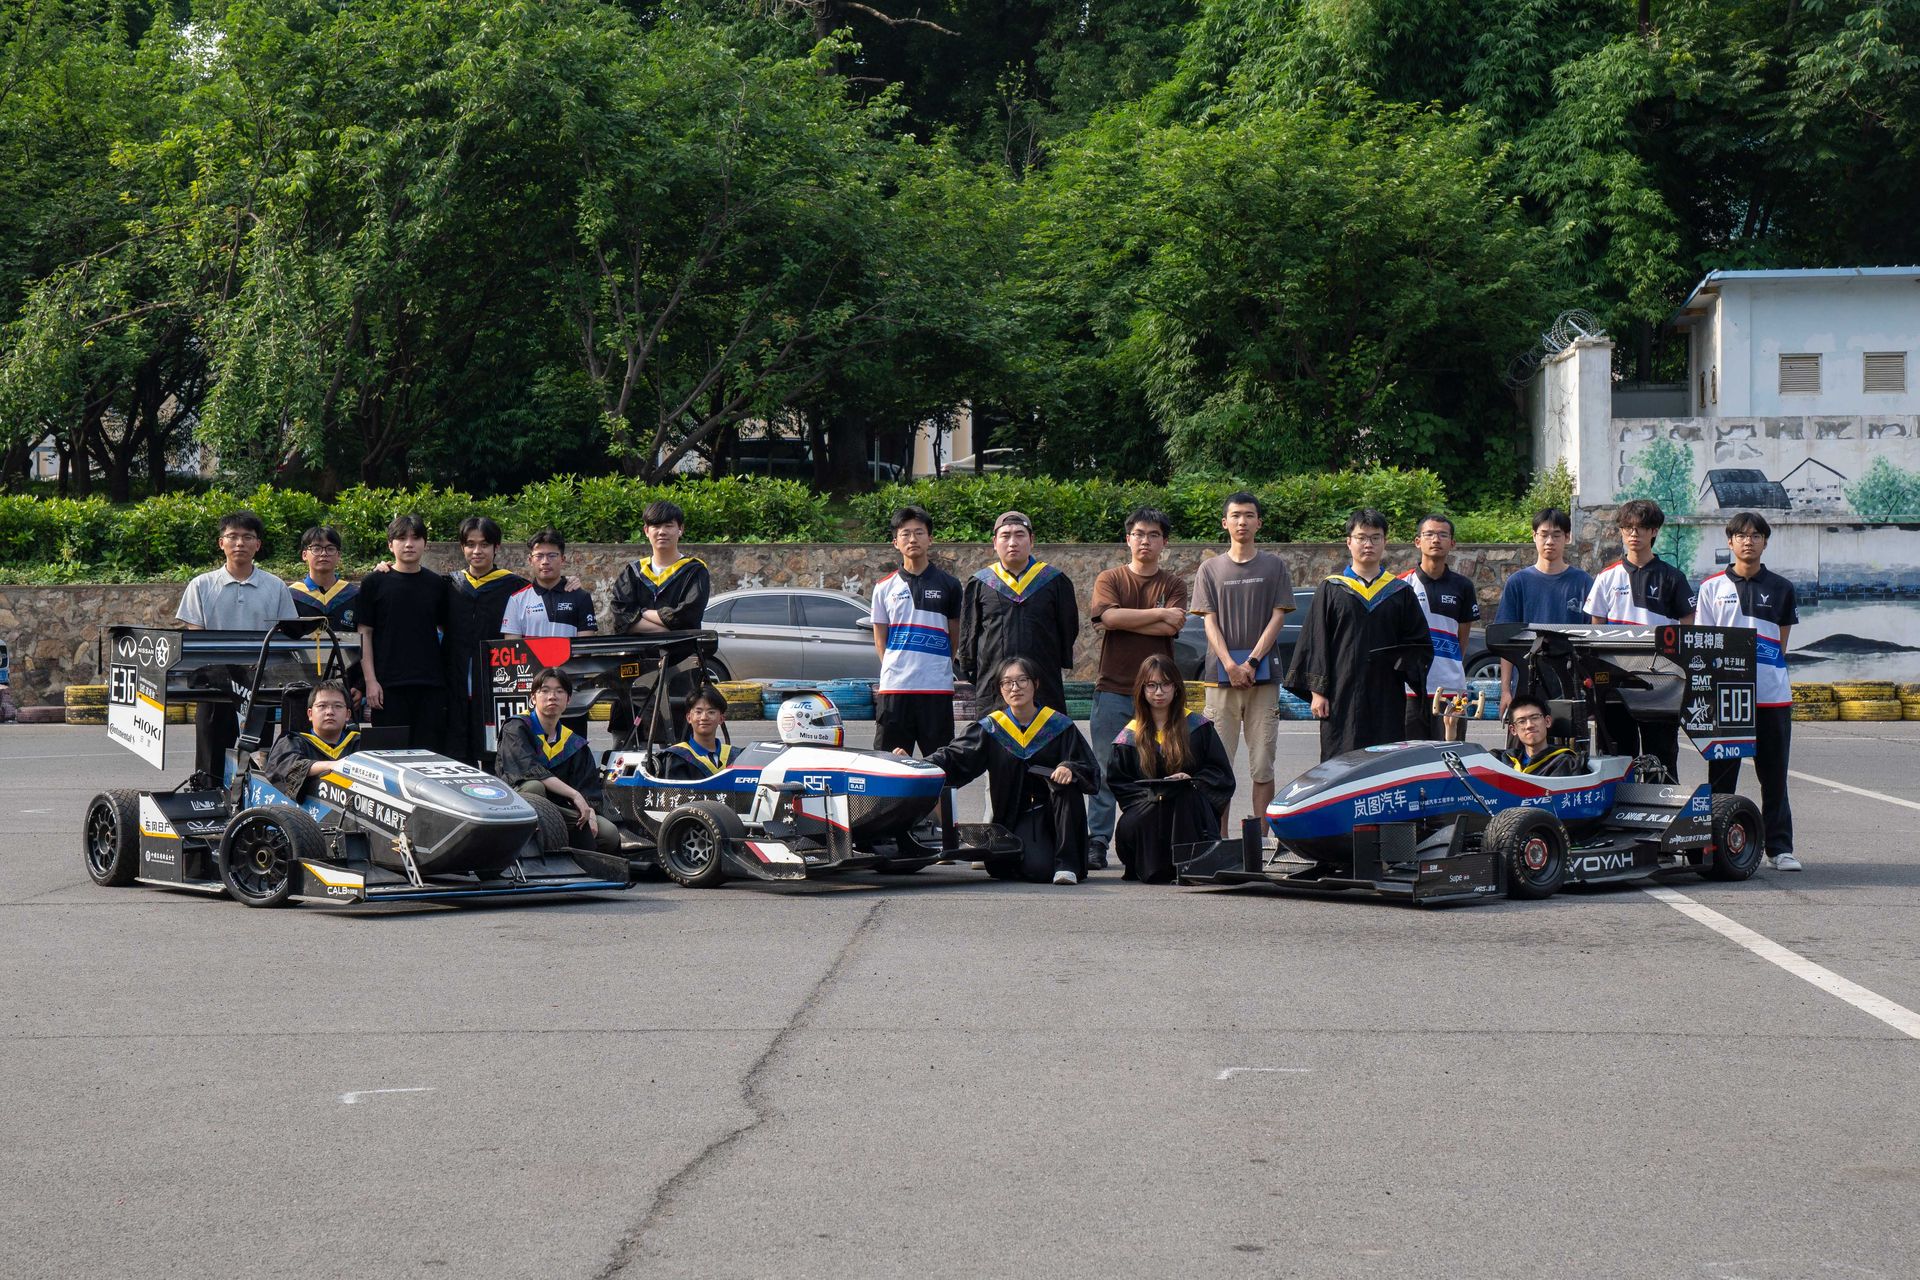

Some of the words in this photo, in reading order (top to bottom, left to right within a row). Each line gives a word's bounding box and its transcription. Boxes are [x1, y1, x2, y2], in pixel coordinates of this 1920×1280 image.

[1684, 632, 1724, 649] 中复神鹰
[138, 647, 154, 655] NISSAN
[490, 647, 520, 667] ZGL
[111, 667, 136, 703] E36
[1692, 675, 1712, 685] SMT
[1720, 689, 1751, 721] E03
[133, 715, 161, 740] HIOKI
[800, 732, 813, 740] Miss
[1726, 747, 1740, 757] NIO
[412, 765, 480, 776] E36
[330, 787, 347, 806] NIO
[1354, 789, 1407, 818] 岚图汽车
[1520, 796, 1552, 806] EVE
[1693, 814, 1711, 823] CALB
[1569, 852, 1634, 872] VOYAH
[327, 886, 347, 895] CALB
